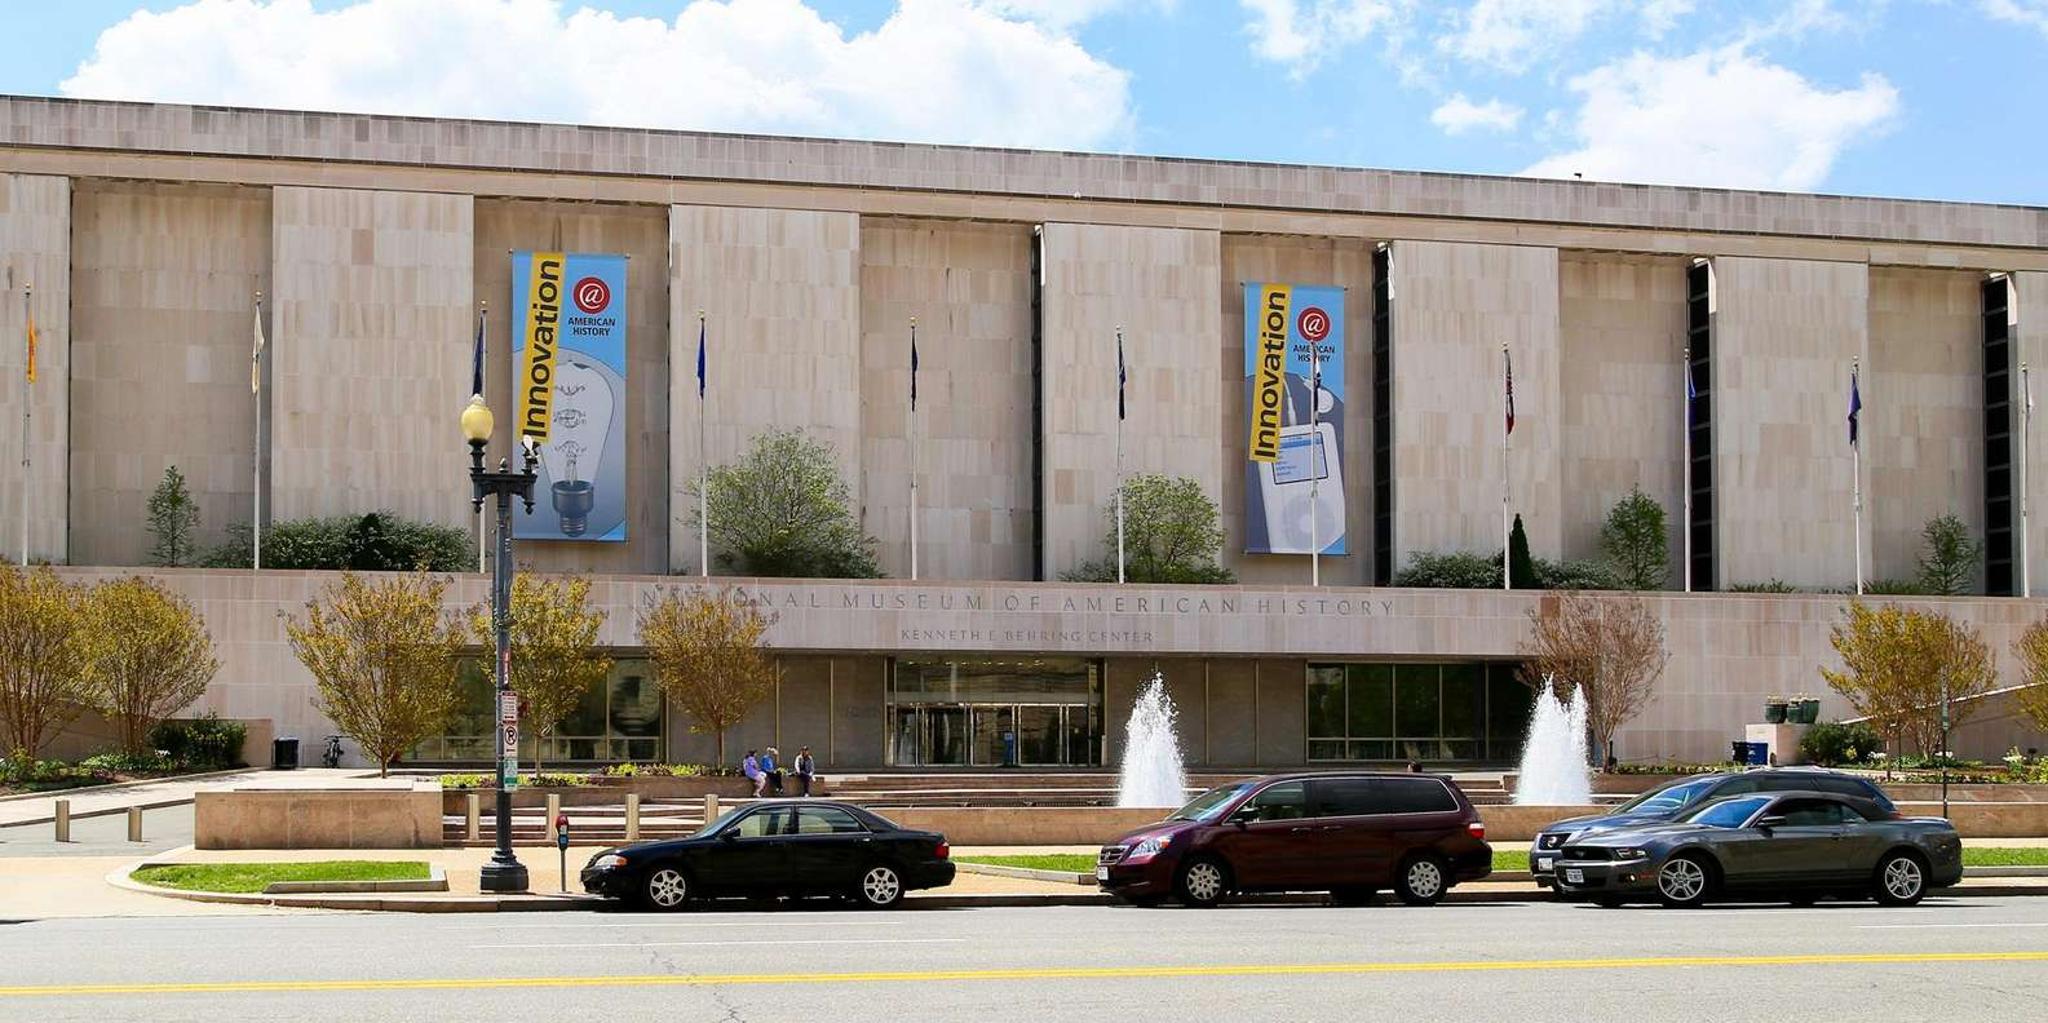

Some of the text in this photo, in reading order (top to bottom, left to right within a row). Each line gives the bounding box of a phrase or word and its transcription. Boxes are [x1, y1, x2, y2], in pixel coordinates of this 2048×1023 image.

[567, 317, 616, 327] AMERICAN
[573, 326, 611, 337] HISTORY
[522, 260, 560, 438] Innovation
[1292, 344, 1336, 354] AMEICAN
[1298, 353, 1331, 362] HISRY
[1254, 291, 1286, 458] Innovation
[642, 588, 1393, 615] NONAL MUSEUM OF AMERICAN HISTORY
[901, 630, 981, 641] KENNETH
[1005, 631, 1083, 642] BEHRING
[1089, 631, 1154, 642] CENTER
